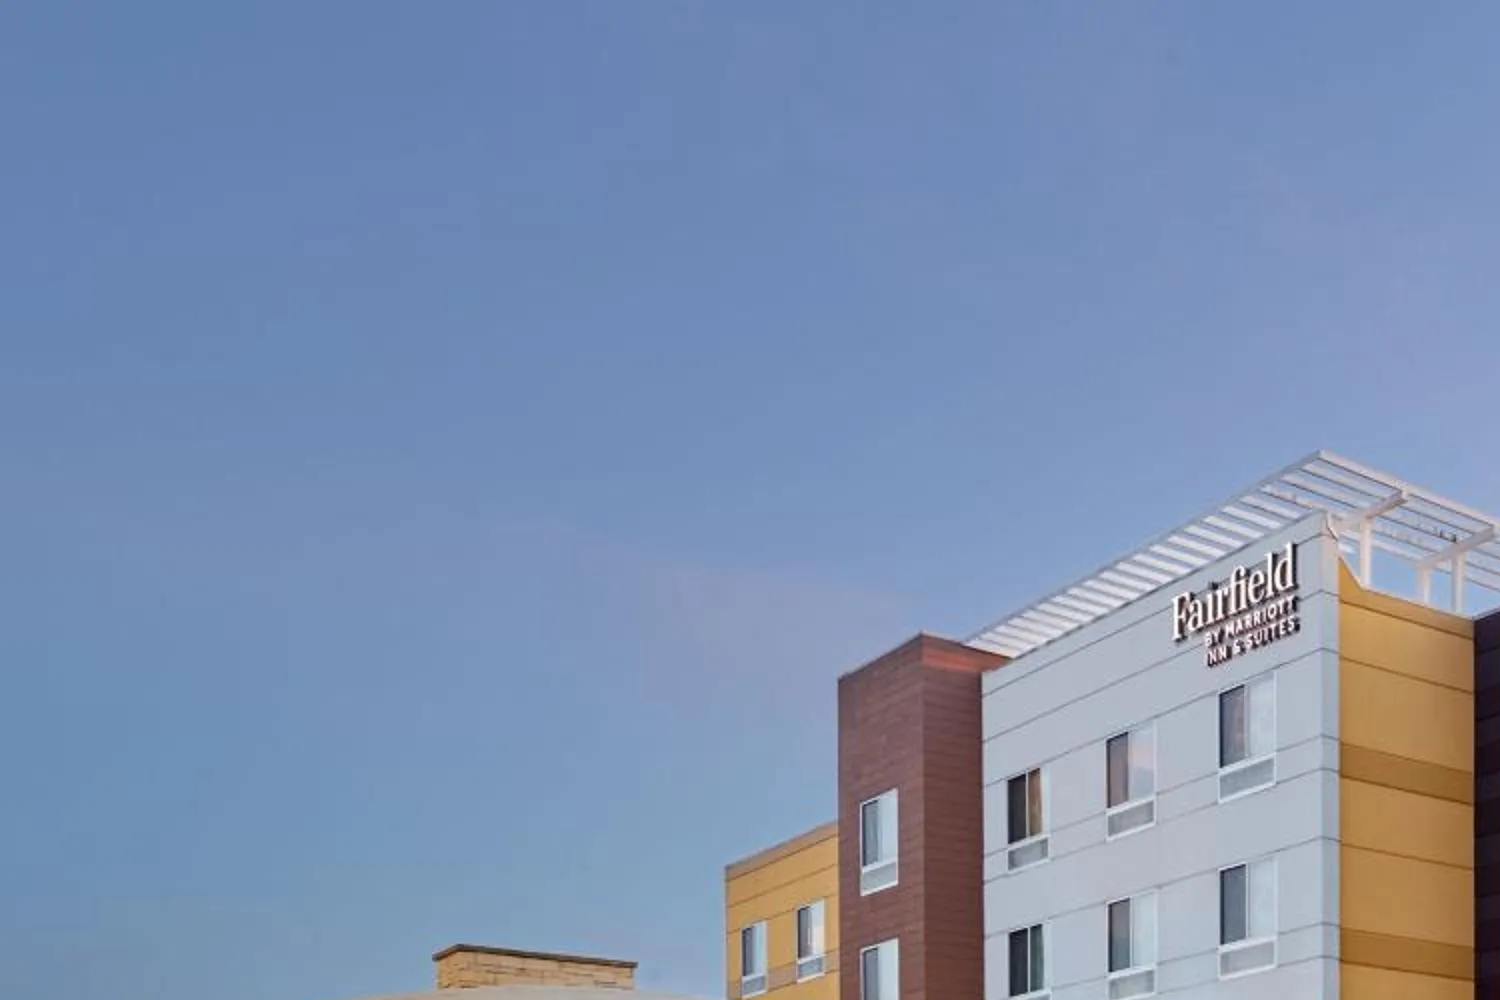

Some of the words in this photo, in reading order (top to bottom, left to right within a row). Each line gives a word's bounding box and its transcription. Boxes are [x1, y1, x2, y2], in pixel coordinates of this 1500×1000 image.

[1172, 541, 1297, 641] Fairfield
[1205, 630, 1224, 647] BY
[1225, 595, 1298, 638] MARRIOTT
[1206, 645, 1231, 667] INN
[1233, 639, 1245, 655] &
[1247, 616, 1299, 649] SUITES
